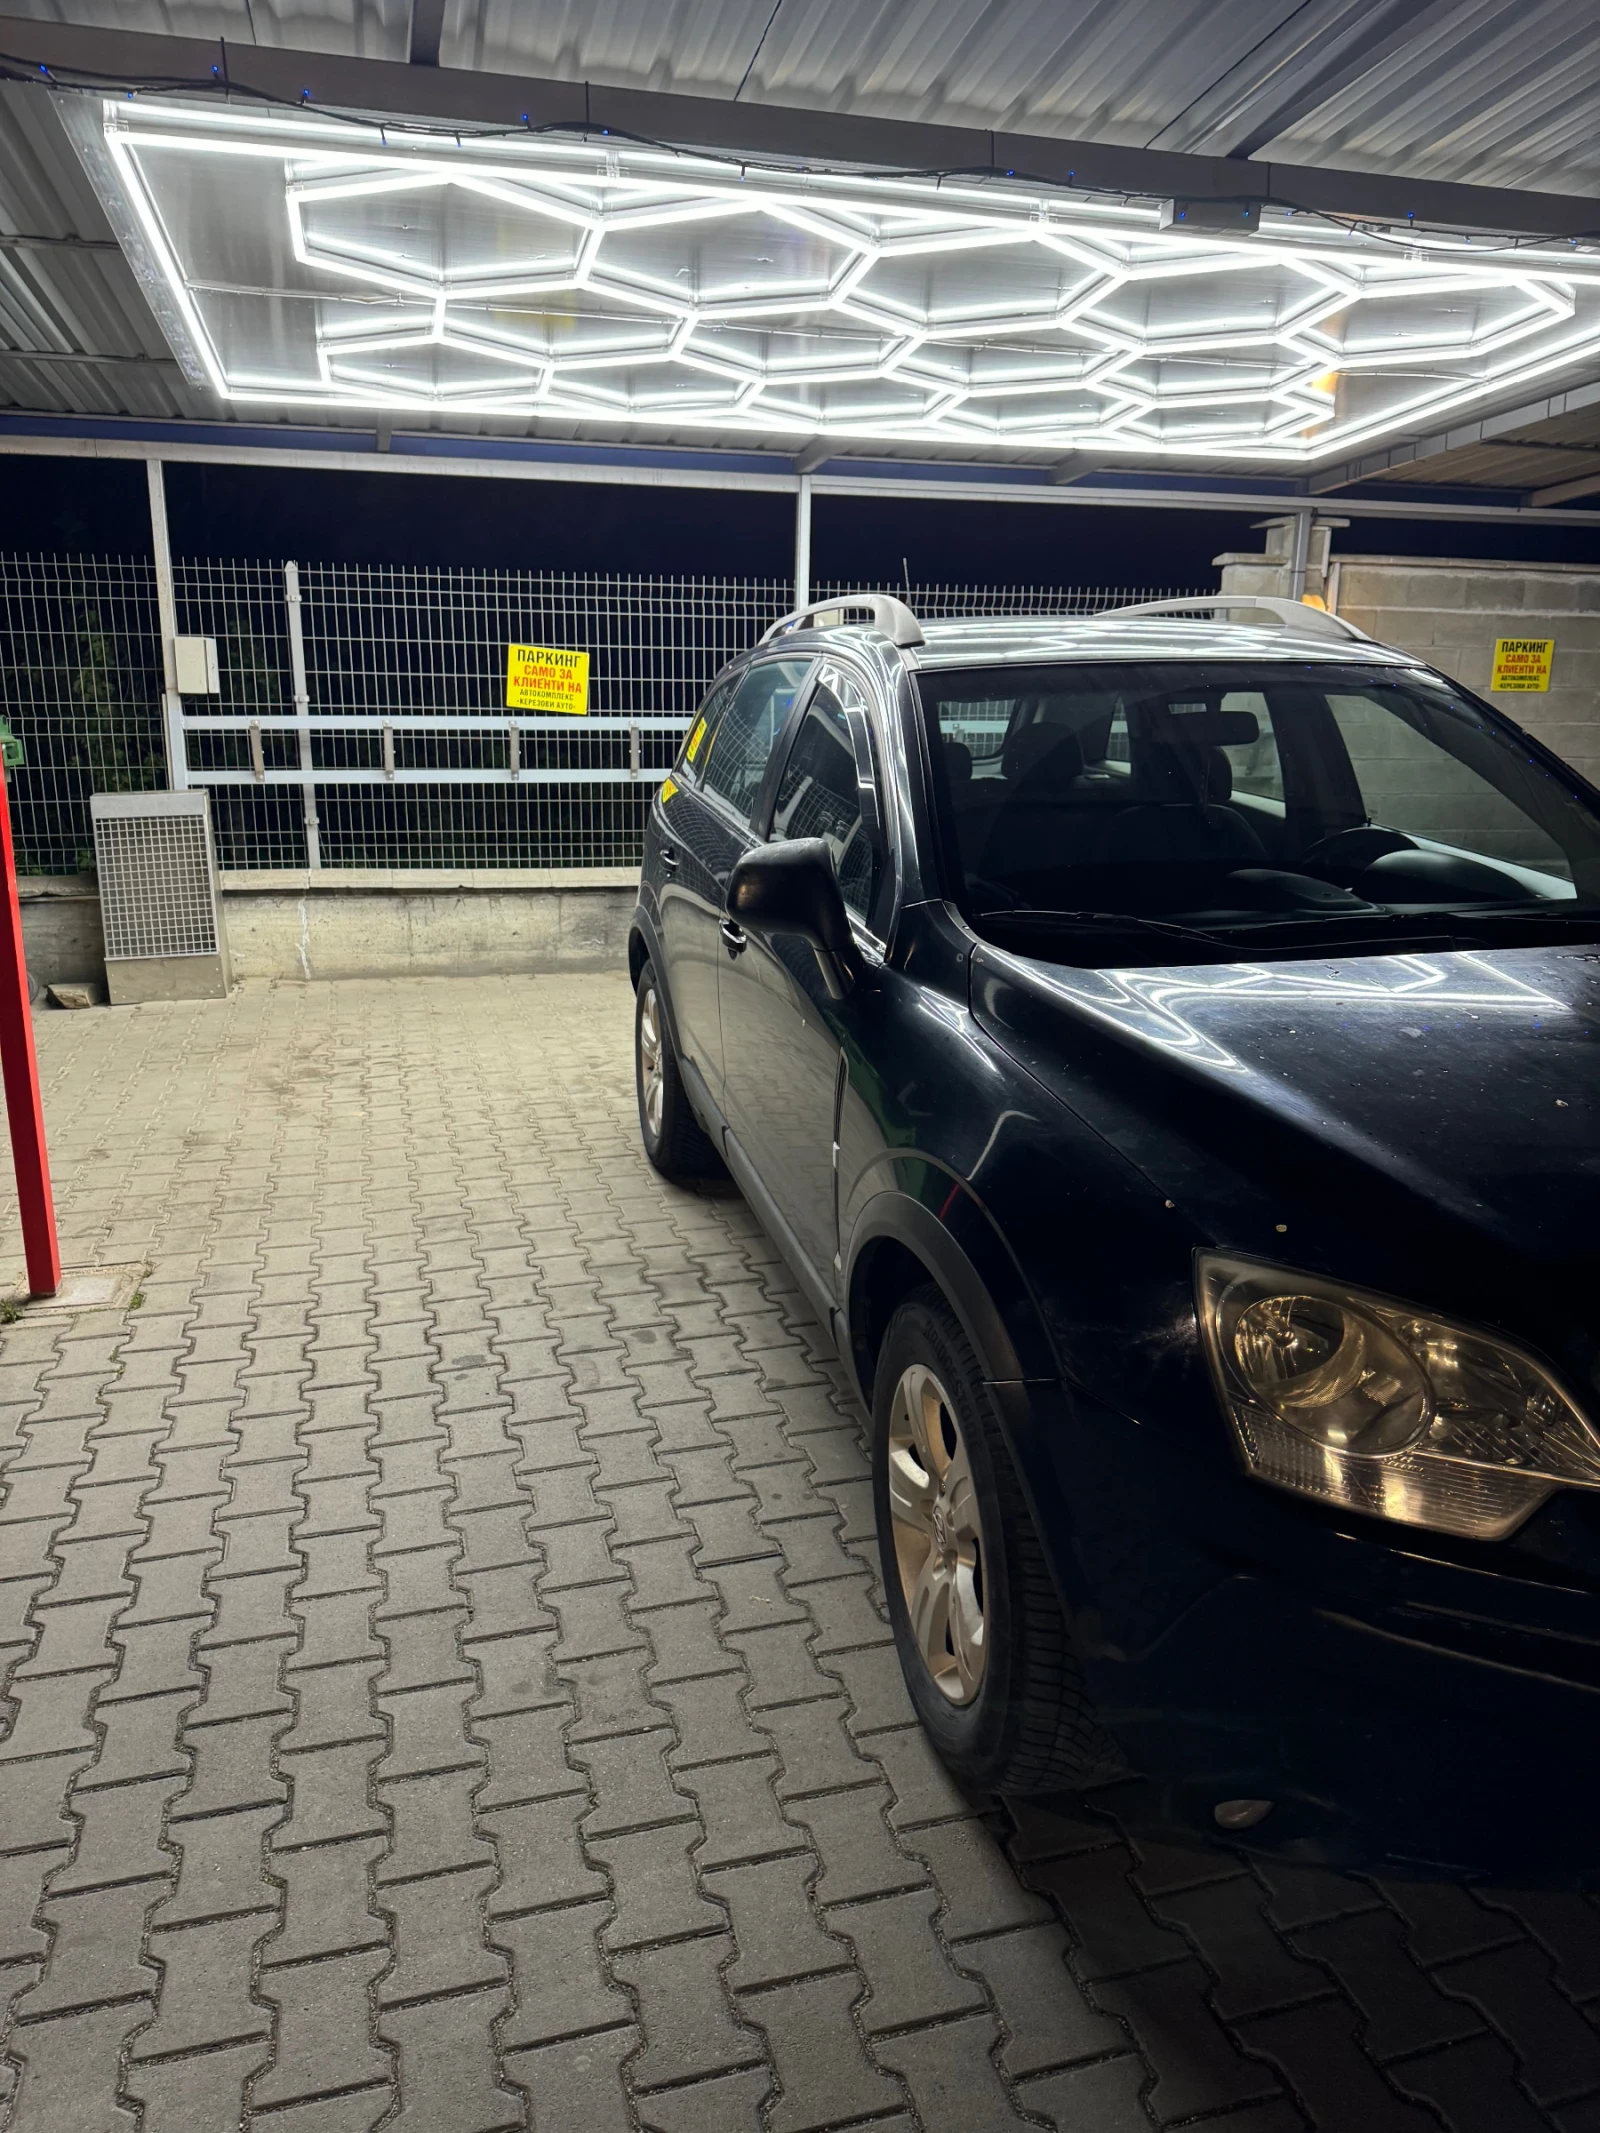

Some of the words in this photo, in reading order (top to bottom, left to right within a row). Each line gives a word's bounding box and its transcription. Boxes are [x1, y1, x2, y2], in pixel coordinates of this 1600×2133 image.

[1501, 641, 1548, 653] ПАРКИНГ
[517, 649, 581, 668] ПАРКИНГ
[1506, 654, 1529, 663] САМО
[1531, 655, 1541, 663] ЗА
[524, 664, 556, 678] САМО
[559, 668, 573, 680] ЗА
[513, 676, 565, 691] КЛИЕНТИ
[568, 682, 582, 693] НА
[519, 689, 574, 701] АВТОКОМПЛЕКС
